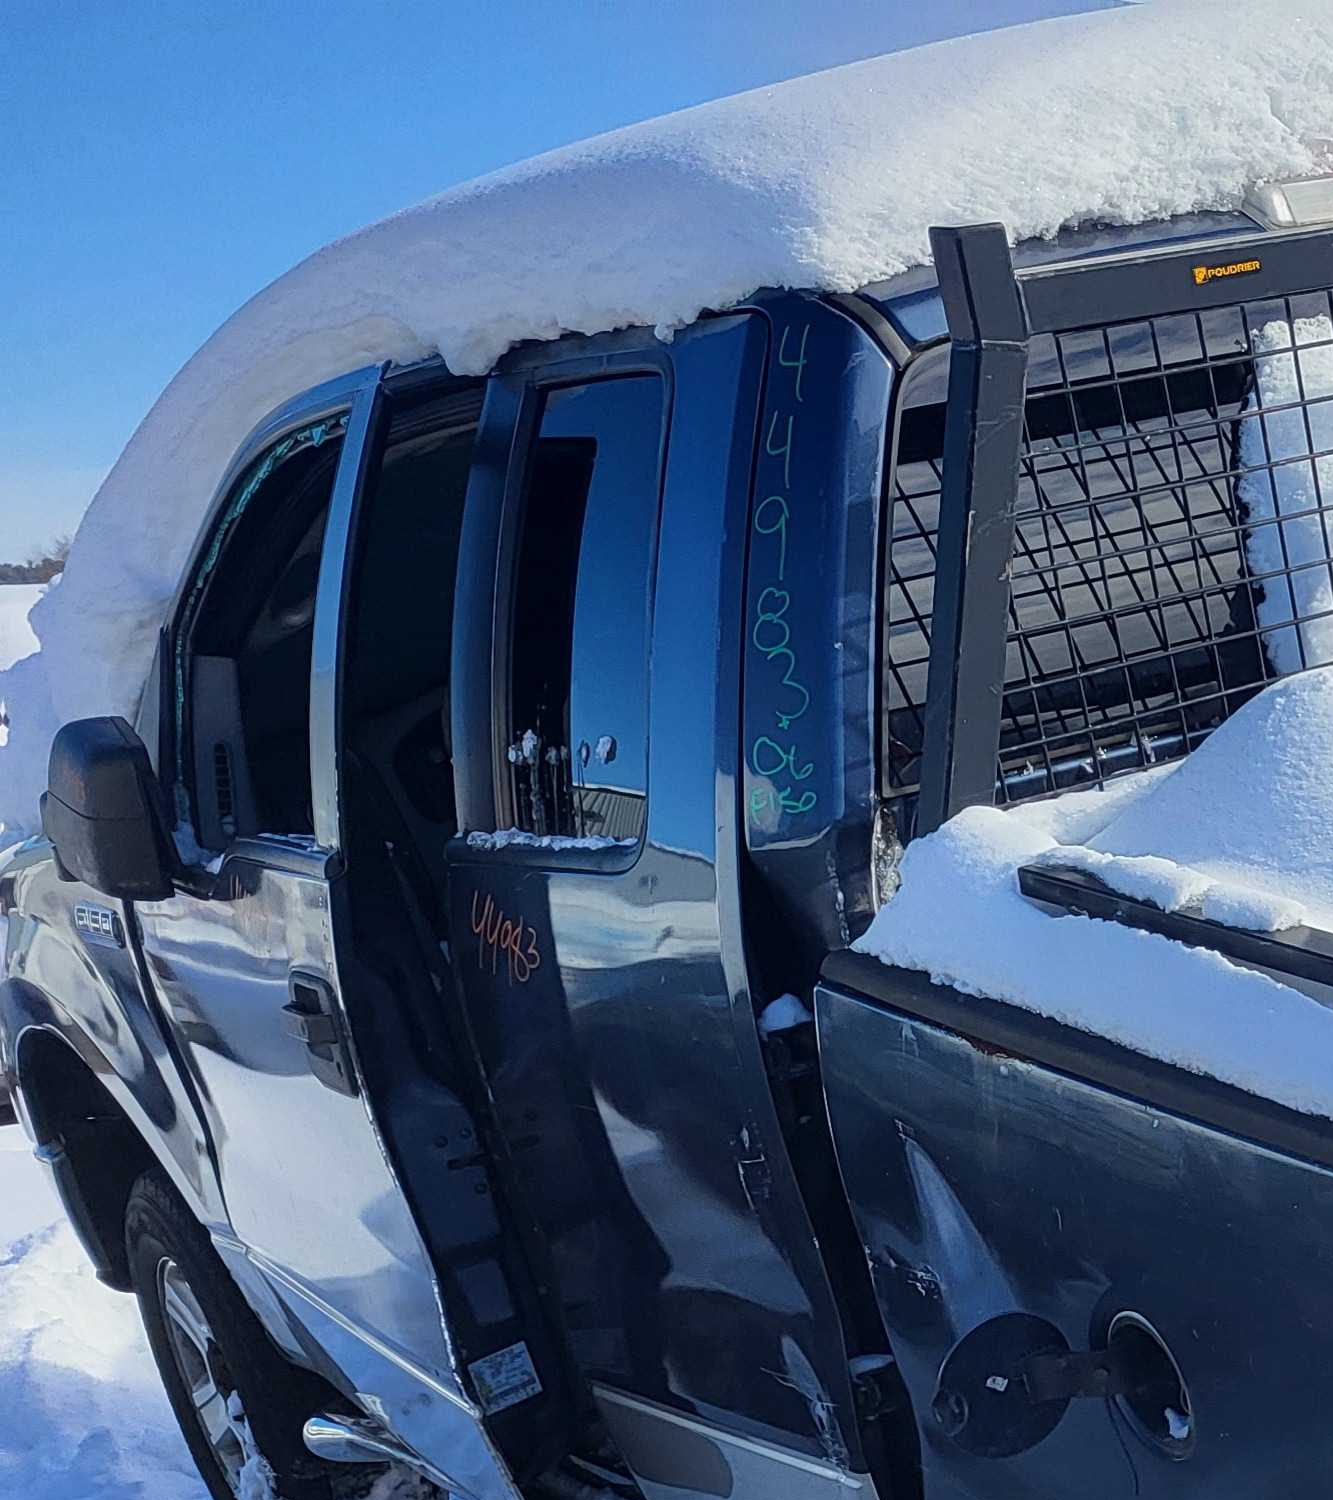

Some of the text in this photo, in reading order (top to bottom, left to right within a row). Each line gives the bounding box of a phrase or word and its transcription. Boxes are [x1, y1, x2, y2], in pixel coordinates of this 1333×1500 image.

[1207, 260, 1261, 278] POUDRIER
[753, 323, 811, 720] 44983
[471, 888, 542, 988] 44983
